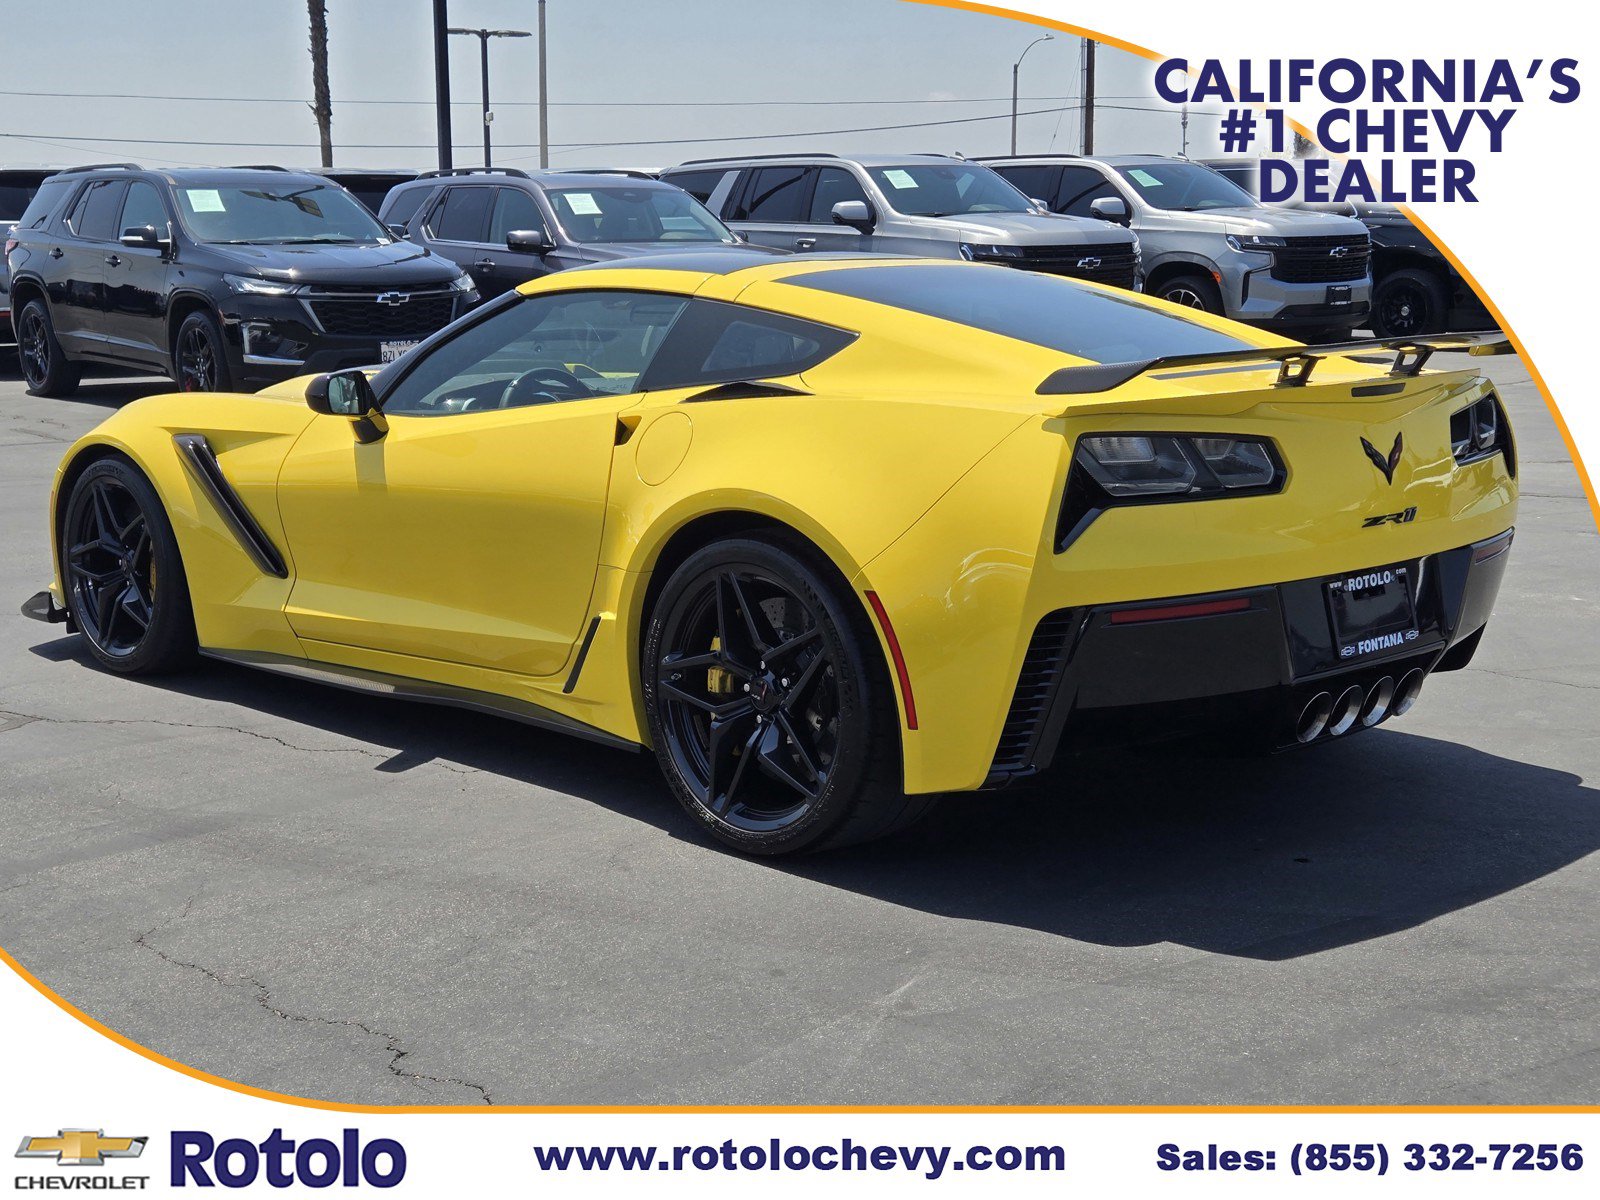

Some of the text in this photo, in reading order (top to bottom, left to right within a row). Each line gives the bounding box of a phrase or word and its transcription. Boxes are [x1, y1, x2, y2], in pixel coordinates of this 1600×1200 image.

[1361, 506, 1418, 528] ZR1
[1348, 570, 1391, 591] ROTOLO
[1358, 632, 1404, 654] FONTANA
